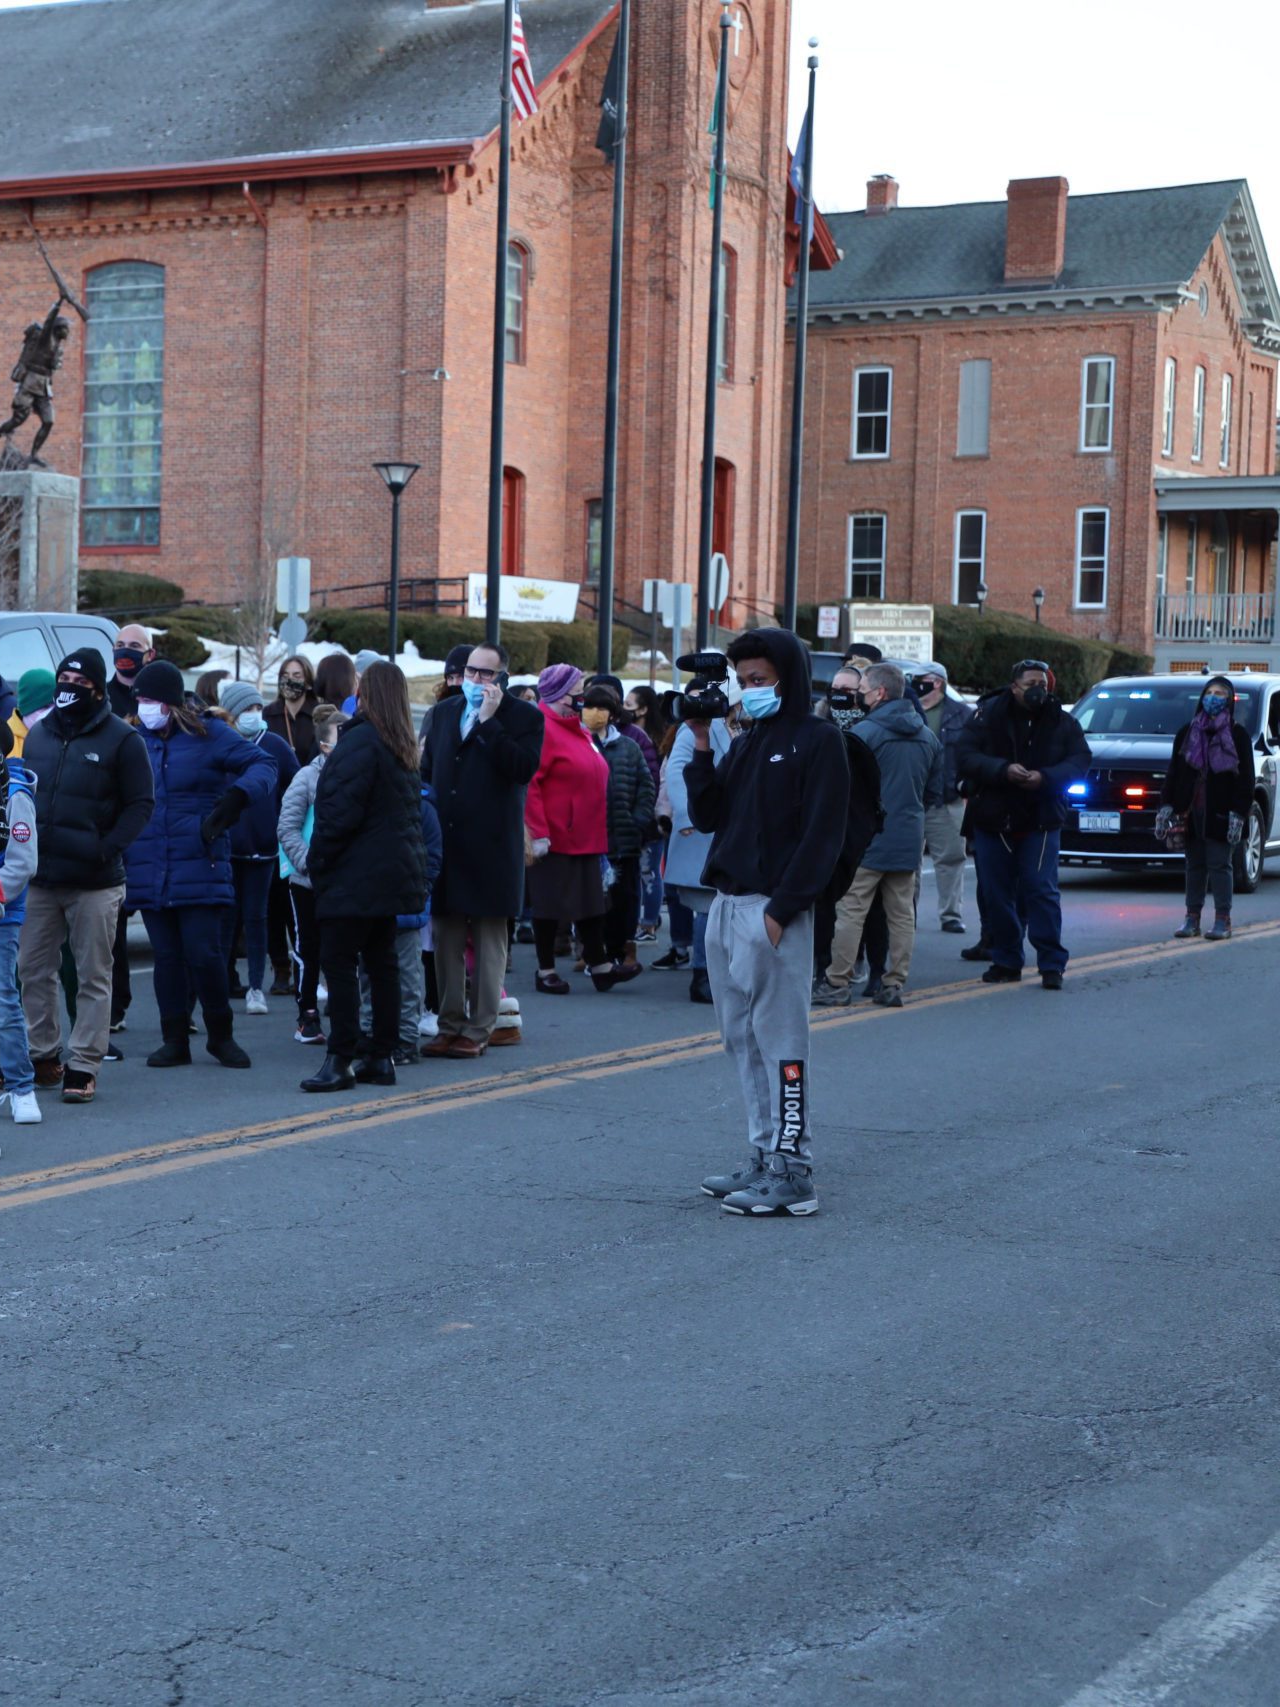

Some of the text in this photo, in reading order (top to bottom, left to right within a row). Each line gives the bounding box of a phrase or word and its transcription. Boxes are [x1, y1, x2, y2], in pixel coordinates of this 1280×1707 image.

[856, 619, 929, 627] REFORMED CHURCH
[59, 691, 76, 702] NIKE
[1087, 818, 1111, 829] POLICE
[780, 1082, 801, 1152] JUST DO IT.
